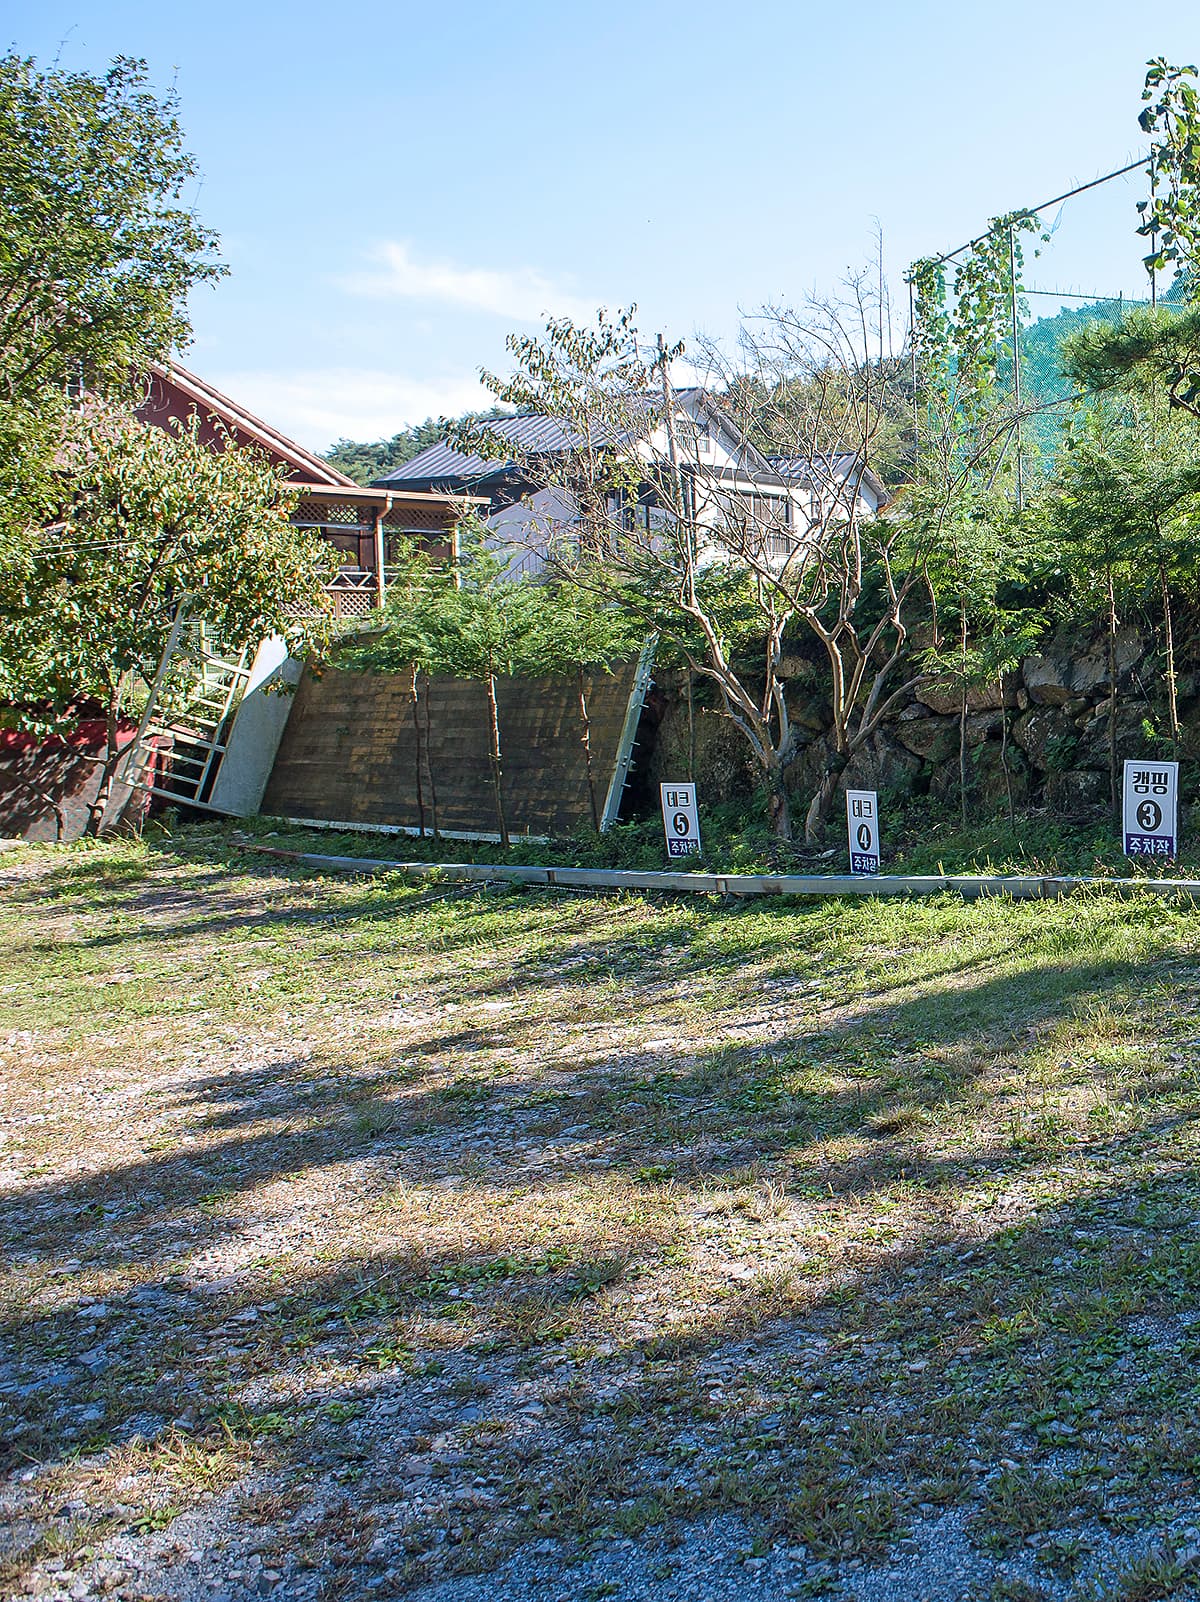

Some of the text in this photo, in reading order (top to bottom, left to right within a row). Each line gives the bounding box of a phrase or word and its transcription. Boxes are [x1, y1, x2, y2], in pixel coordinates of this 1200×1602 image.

[1132, 771, 1168, 794] 캠핑
[667, 791, 690, 807] 데크
[852, 799, 873, 818] 데크
[676, 815, 686, 834] 5
[1142, 803, 1156, 828] 3
[860, 826, 869, 849] 4
[1129, 837, 1170, 855] 주차장
[671, 841, 697, 854] 주차장
[854, 856, 876, 872] 주차장
